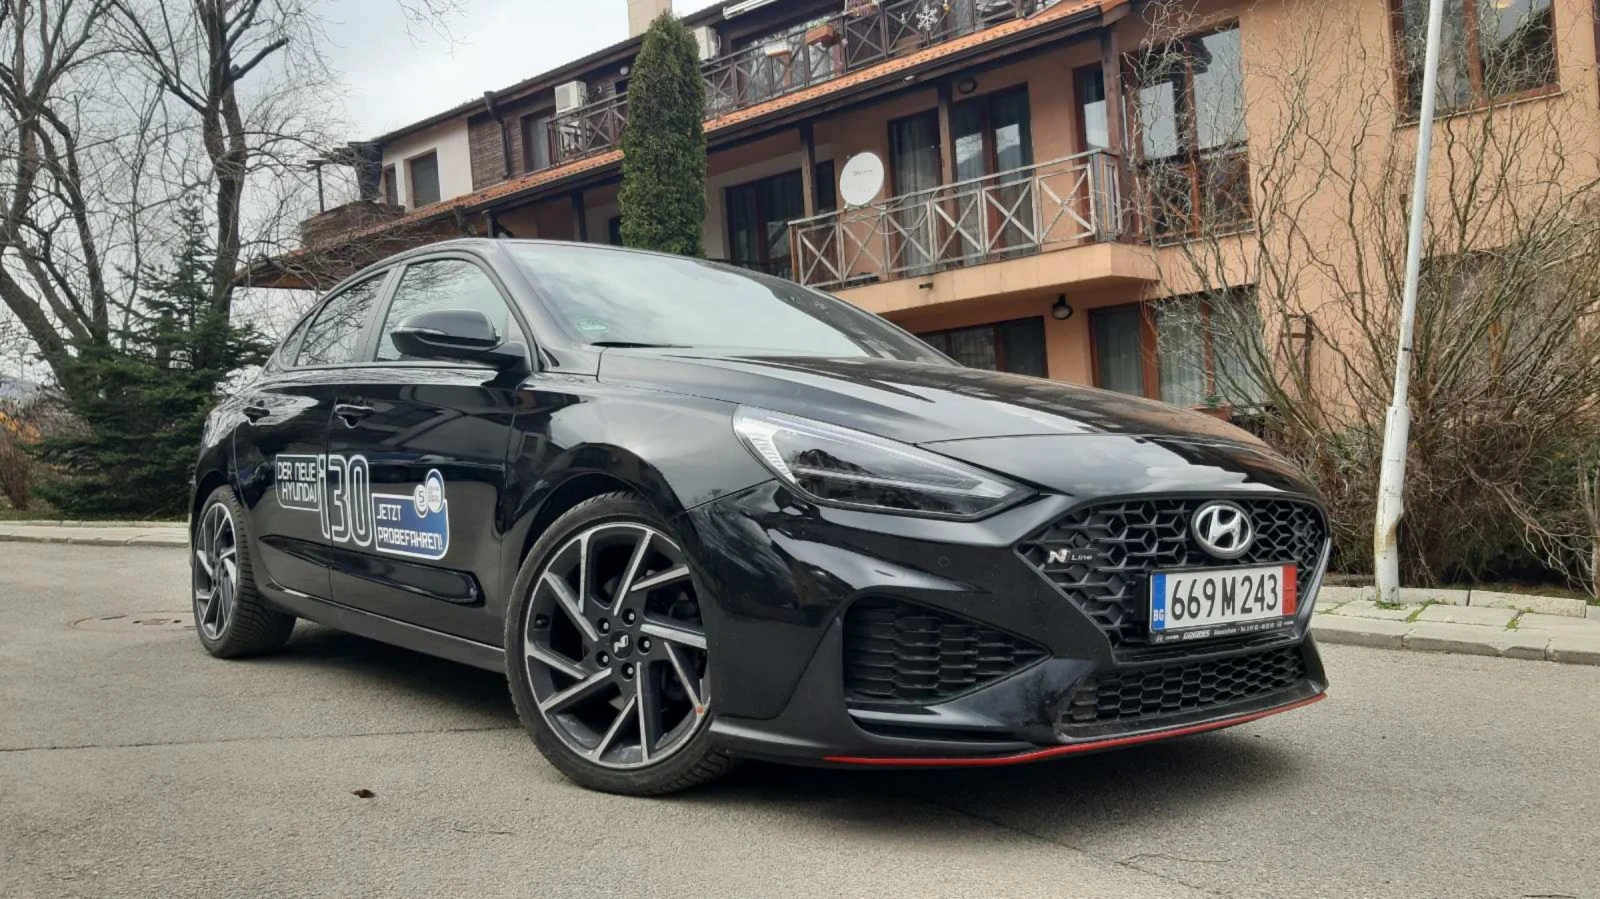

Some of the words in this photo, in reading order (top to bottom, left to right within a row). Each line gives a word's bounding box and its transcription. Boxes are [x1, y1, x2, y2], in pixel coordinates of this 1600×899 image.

[277, 461, 292, 480] DER
[281, 481, 317, 503] HYUNDAI
[377, 504, 402, 521] JETZT
[1153, 609, 1165, 621] BG
